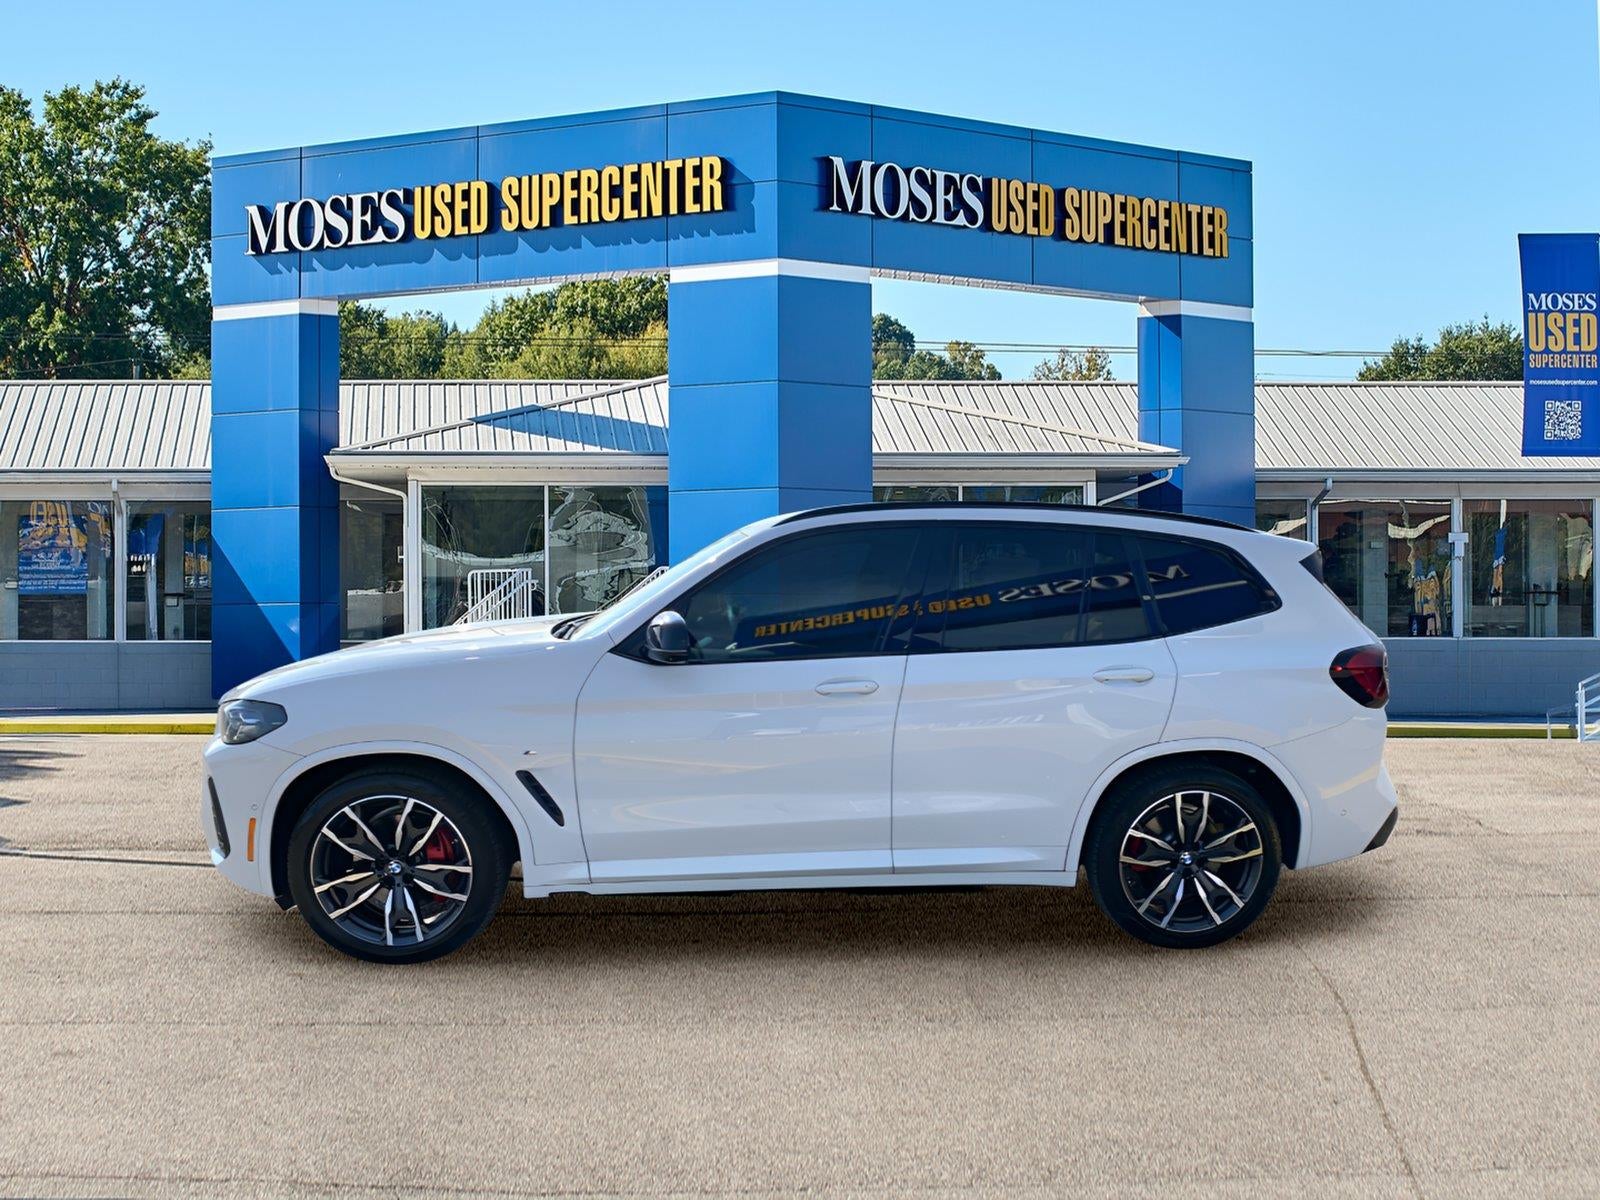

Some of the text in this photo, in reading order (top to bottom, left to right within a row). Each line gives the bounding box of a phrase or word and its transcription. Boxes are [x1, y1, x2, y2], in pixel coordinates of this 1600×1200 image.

[244, 155, 724, 256] MOSES USED SUPERCENTER
[828, 155, 1230, 258] MOSES USED SUPERCENTER
[1527, 292, 1597, 311] MOSES
[1528, 312, 1598, 352] USED
[1529, 354, 1598, 369] SUPERCENTER
